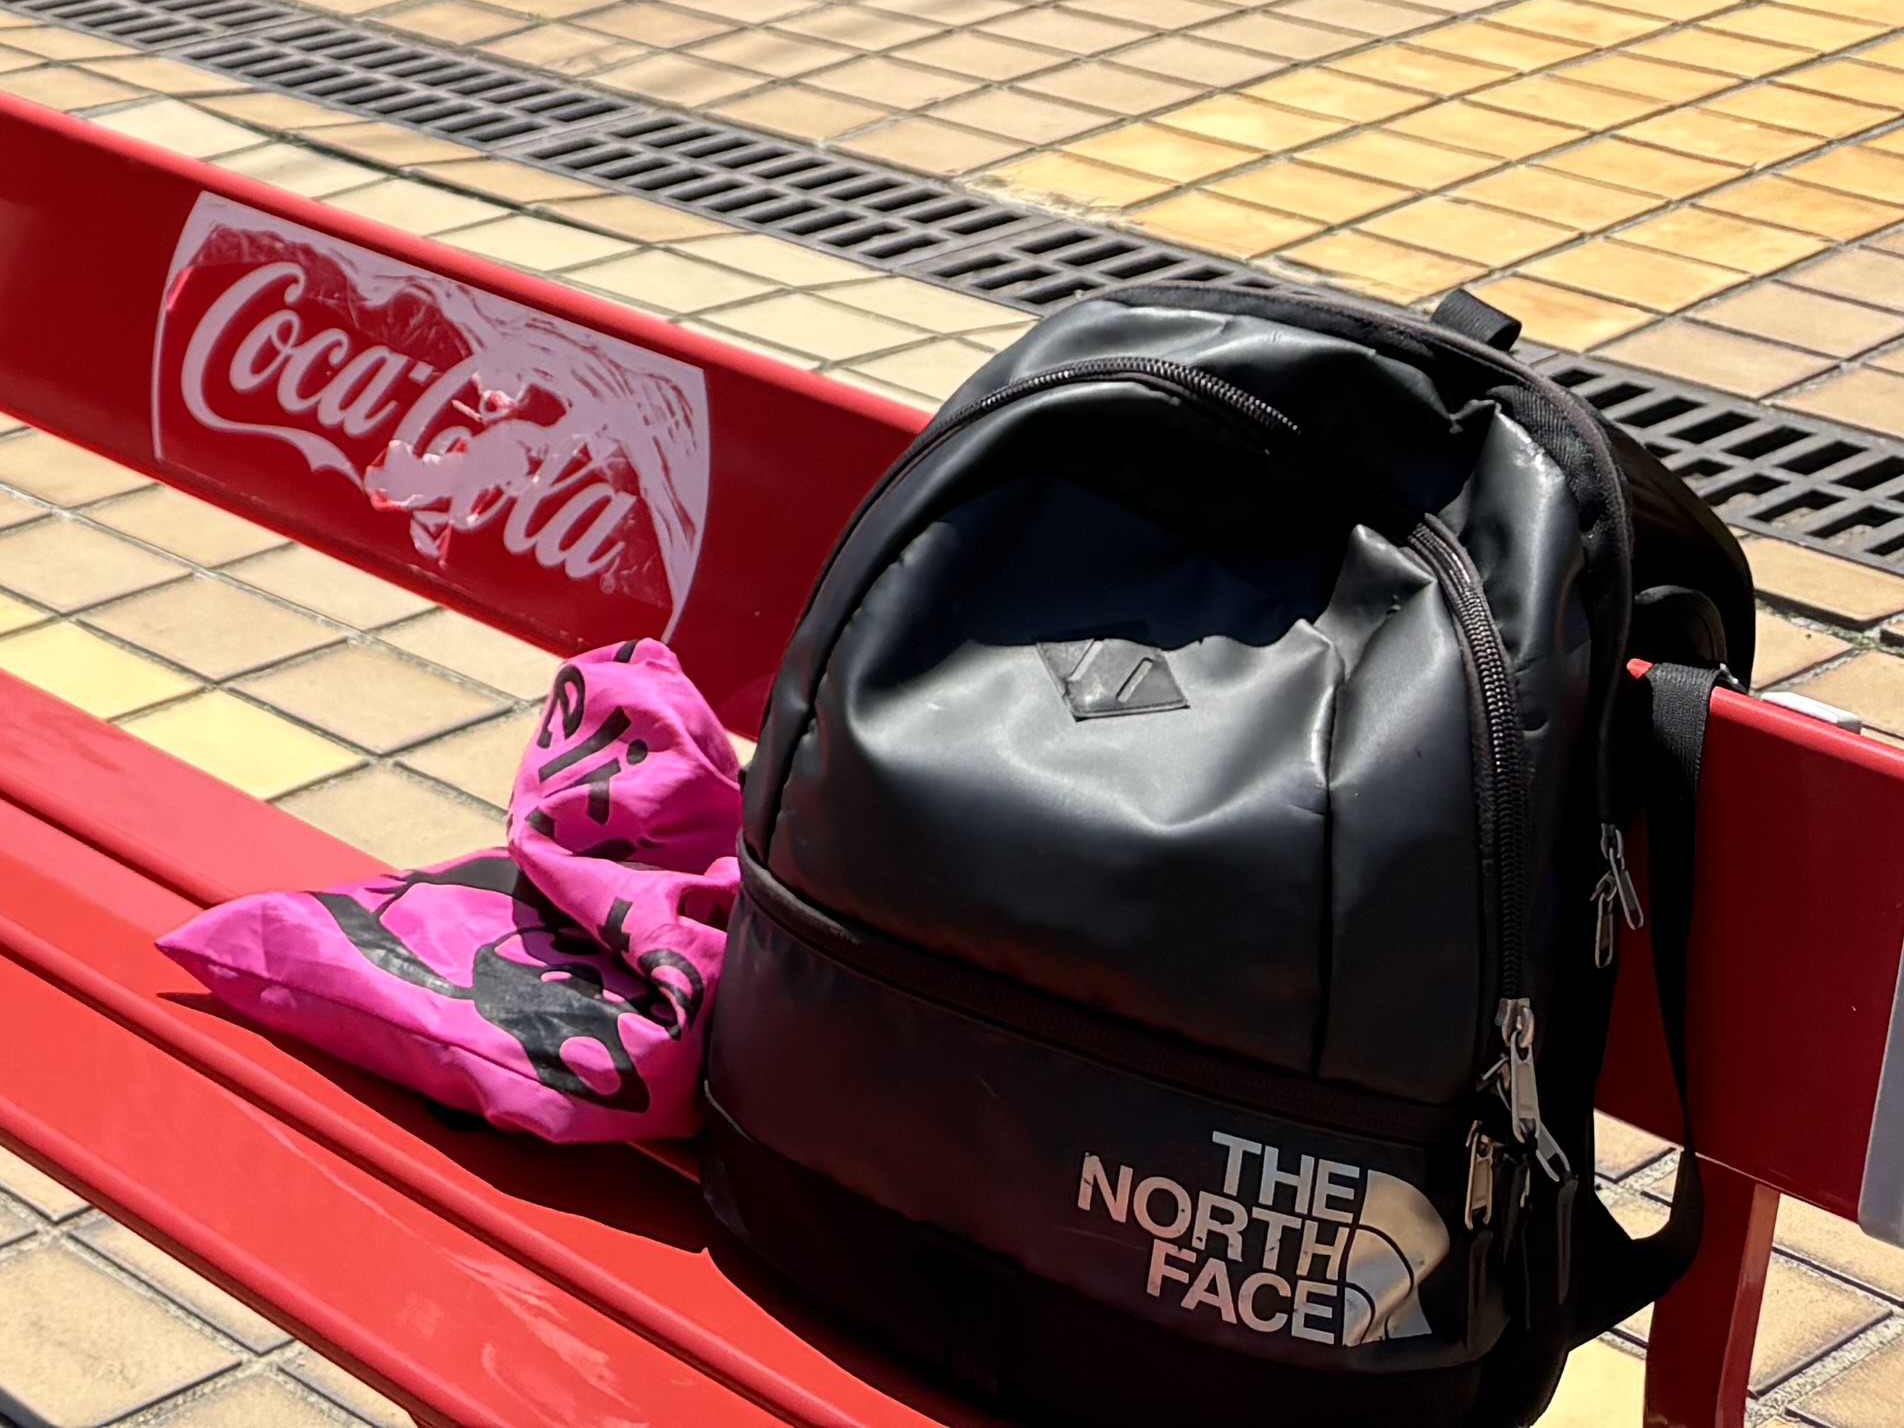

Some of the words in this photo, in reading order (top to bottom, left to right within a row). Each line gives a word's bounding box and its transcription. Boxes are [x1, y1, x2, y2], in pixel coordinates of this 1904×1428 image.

[1078, 1152, 1351, 1281] NORTH
[1213, 1131, 1360, 1224] THE
[1146, 1239, 1338, 1345] FACE
